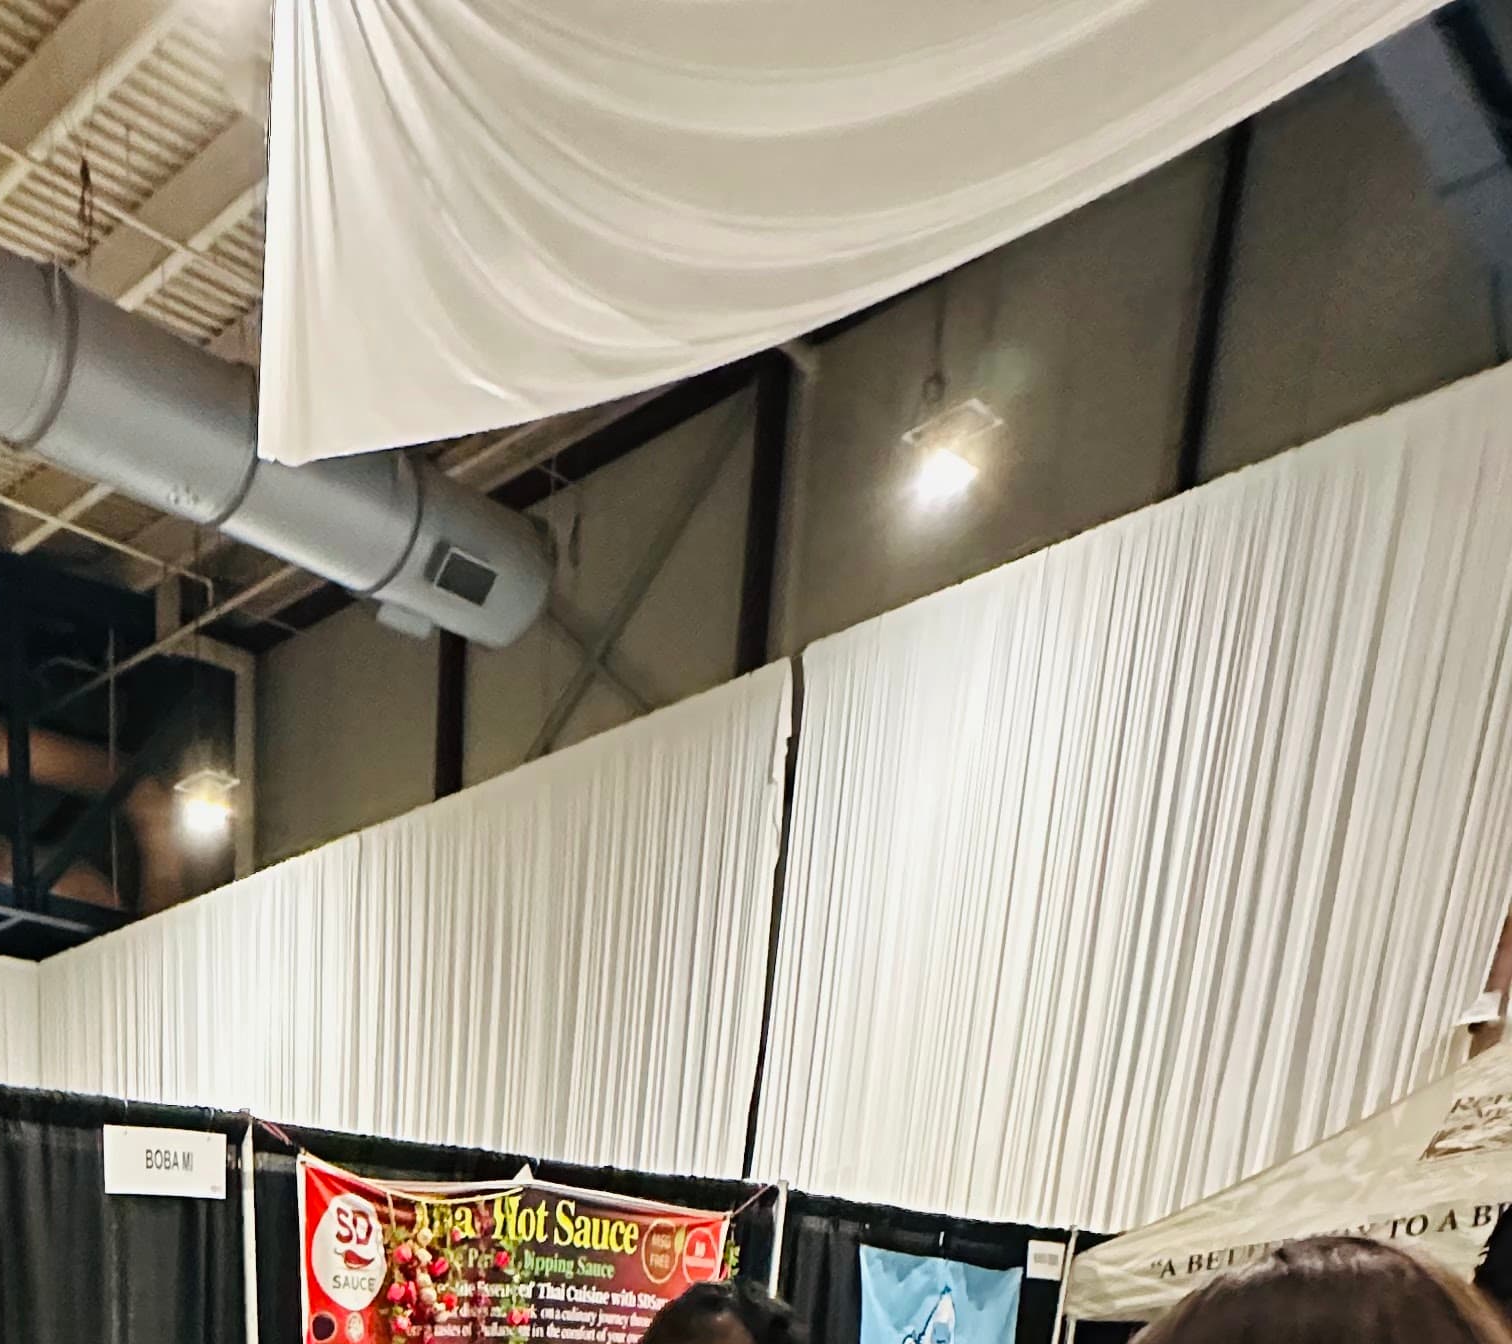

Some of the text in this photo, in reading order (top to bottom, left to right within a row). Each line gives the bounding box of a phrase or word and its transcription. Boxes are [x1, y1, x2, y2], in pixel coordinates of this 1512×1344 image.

[145, 1149, 193, 1171] BOBA MI
[335, 1207, 374, 1245] SD
[490, 1195, 548, 1244] Hot
[553, 1200, 639, 1255] Sauce
[1389, 1214, 1428, 1239] TO
[1436, 1208, 1460, 1233] A
[576, 1255, 615, 1279] Sauce
[332, 1275, 377, 1292] SAUCE
[537, 1282, 566, 1301] Thai
[566, 1284, 609, 1305] Cuisine
[611, 1288, 637, 1308] with
